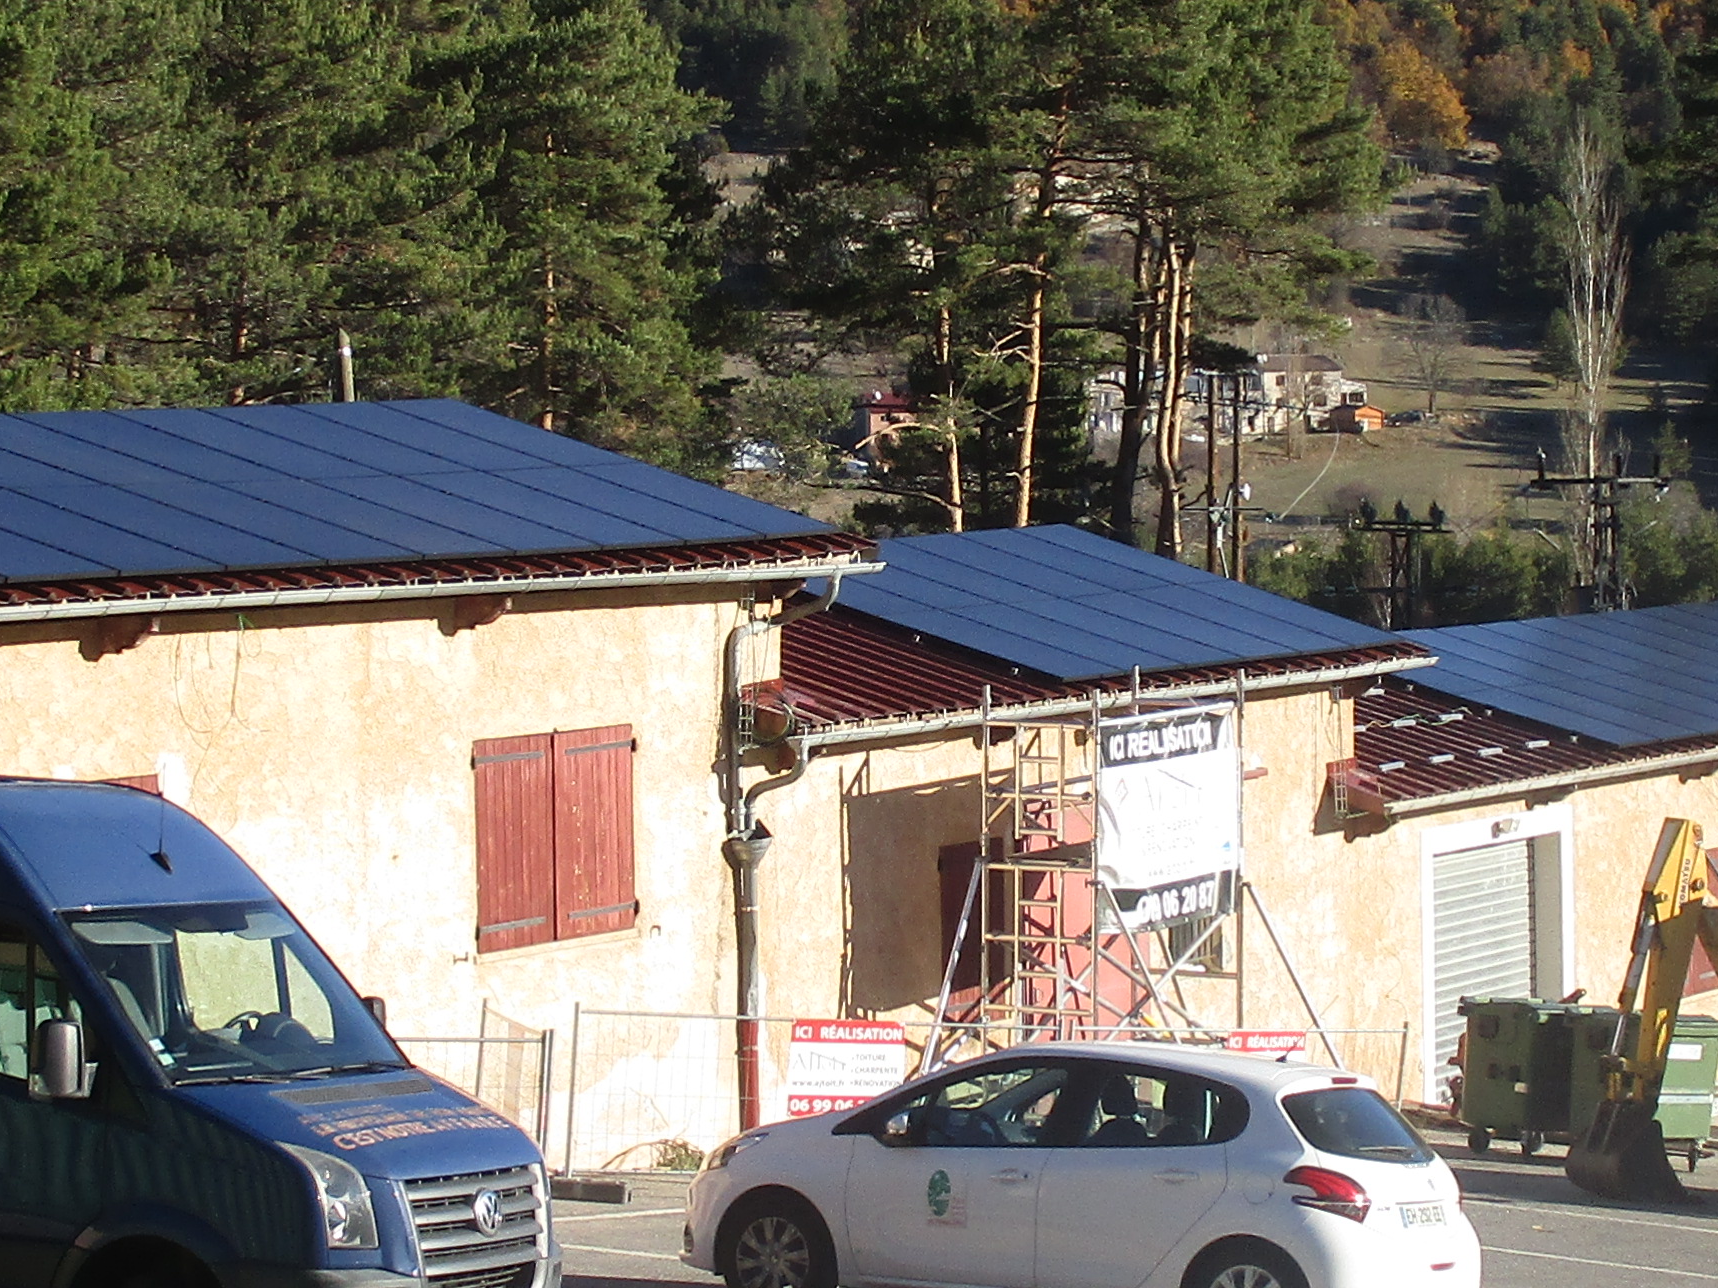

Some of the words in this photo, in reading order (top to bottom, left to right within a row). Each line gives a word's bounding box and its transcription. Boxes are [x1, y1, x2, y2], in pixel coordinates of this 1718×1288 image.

[1109, 734, 1125, 761] ICI
[1162, 888, 1180, 919] 06
[1181, 884, 1197, 915] 20
[1198, 880, 1214, 910] 87
[795, 1025, 813, 1039] ICI
[820, 1023, 903, 1041] RÉALISATION
[1229, 1036, 1243, 1049] ICI
[855, 1054, 886, 1062] TOITURE
[854, 1067, 898, 1075] CHARPENTE
[790, 1098, 810, 1112] 06
[812, 1099, 832, 1113] 99
